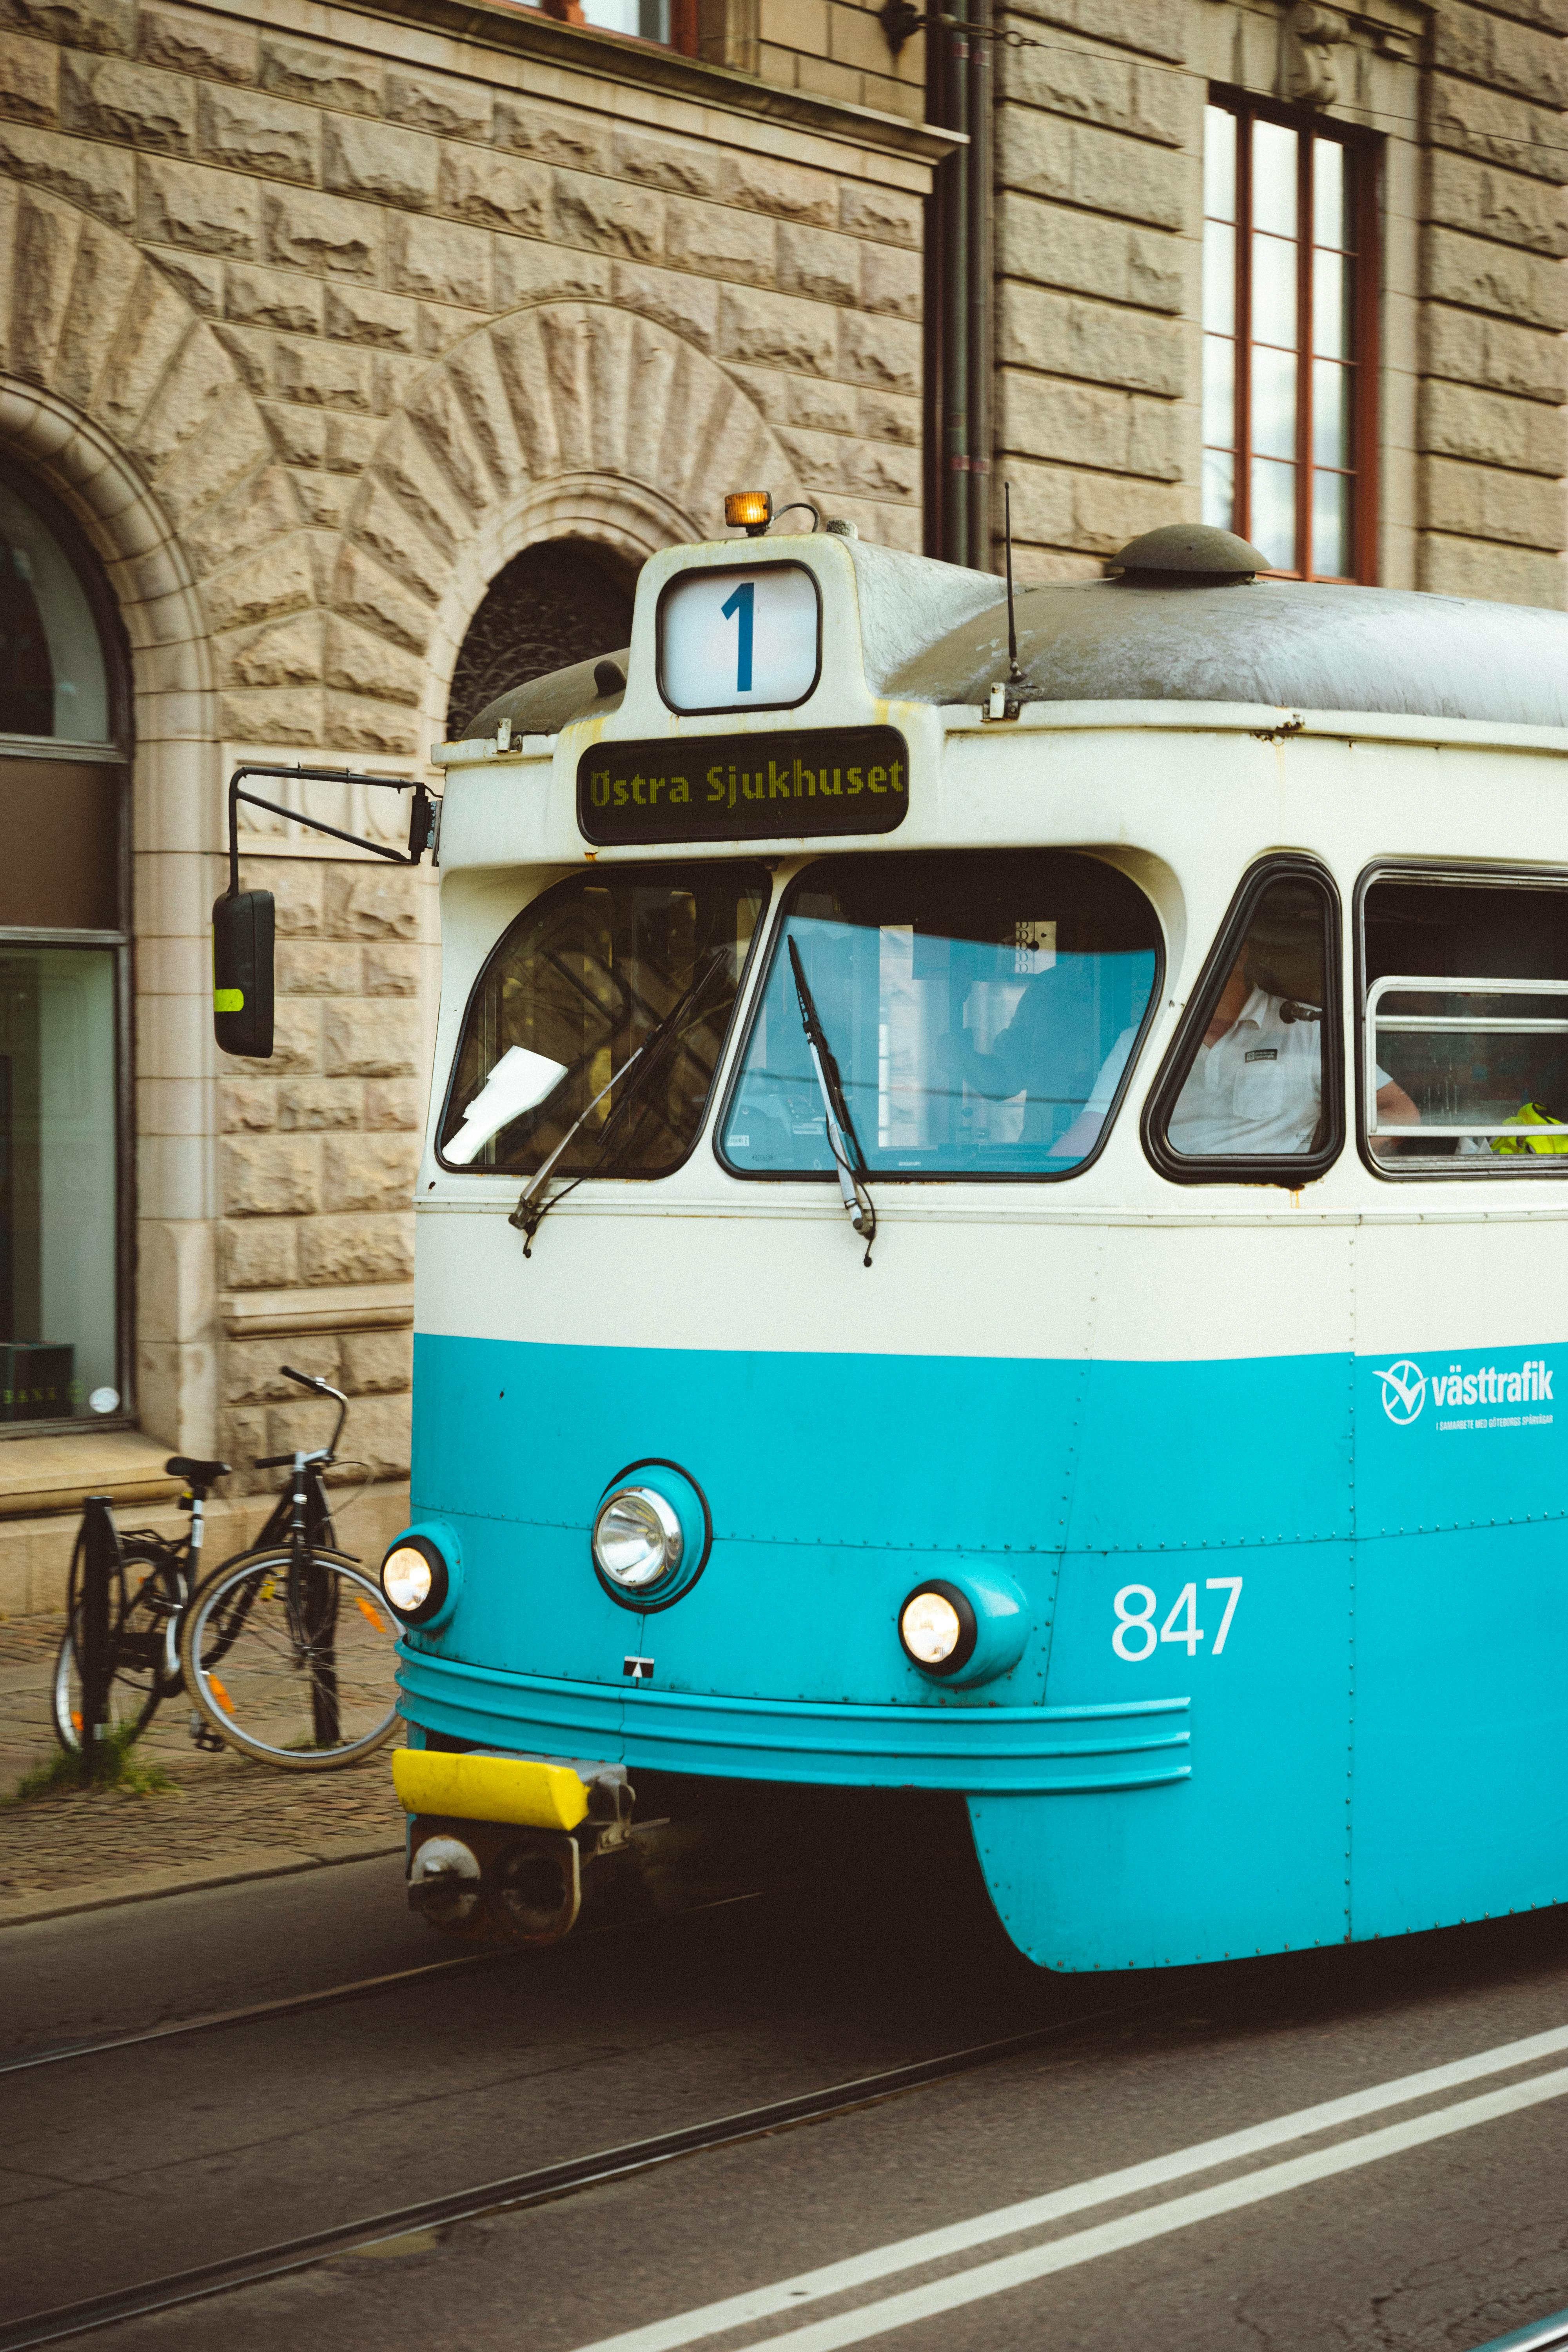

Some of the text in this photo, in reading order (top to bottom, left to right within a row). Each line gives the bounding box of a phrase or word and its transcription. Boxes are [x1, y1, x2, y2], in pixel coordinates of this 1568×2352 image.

[720, 582, 754, 691] 1
[590, 759, 904, 808] Östra Sjukhuset
[1431, 1360, 1554, 1406] västtrafik
[1475, 1419, 1488, 1428] MED
[1112, 1576, 1243, 1662] 847
